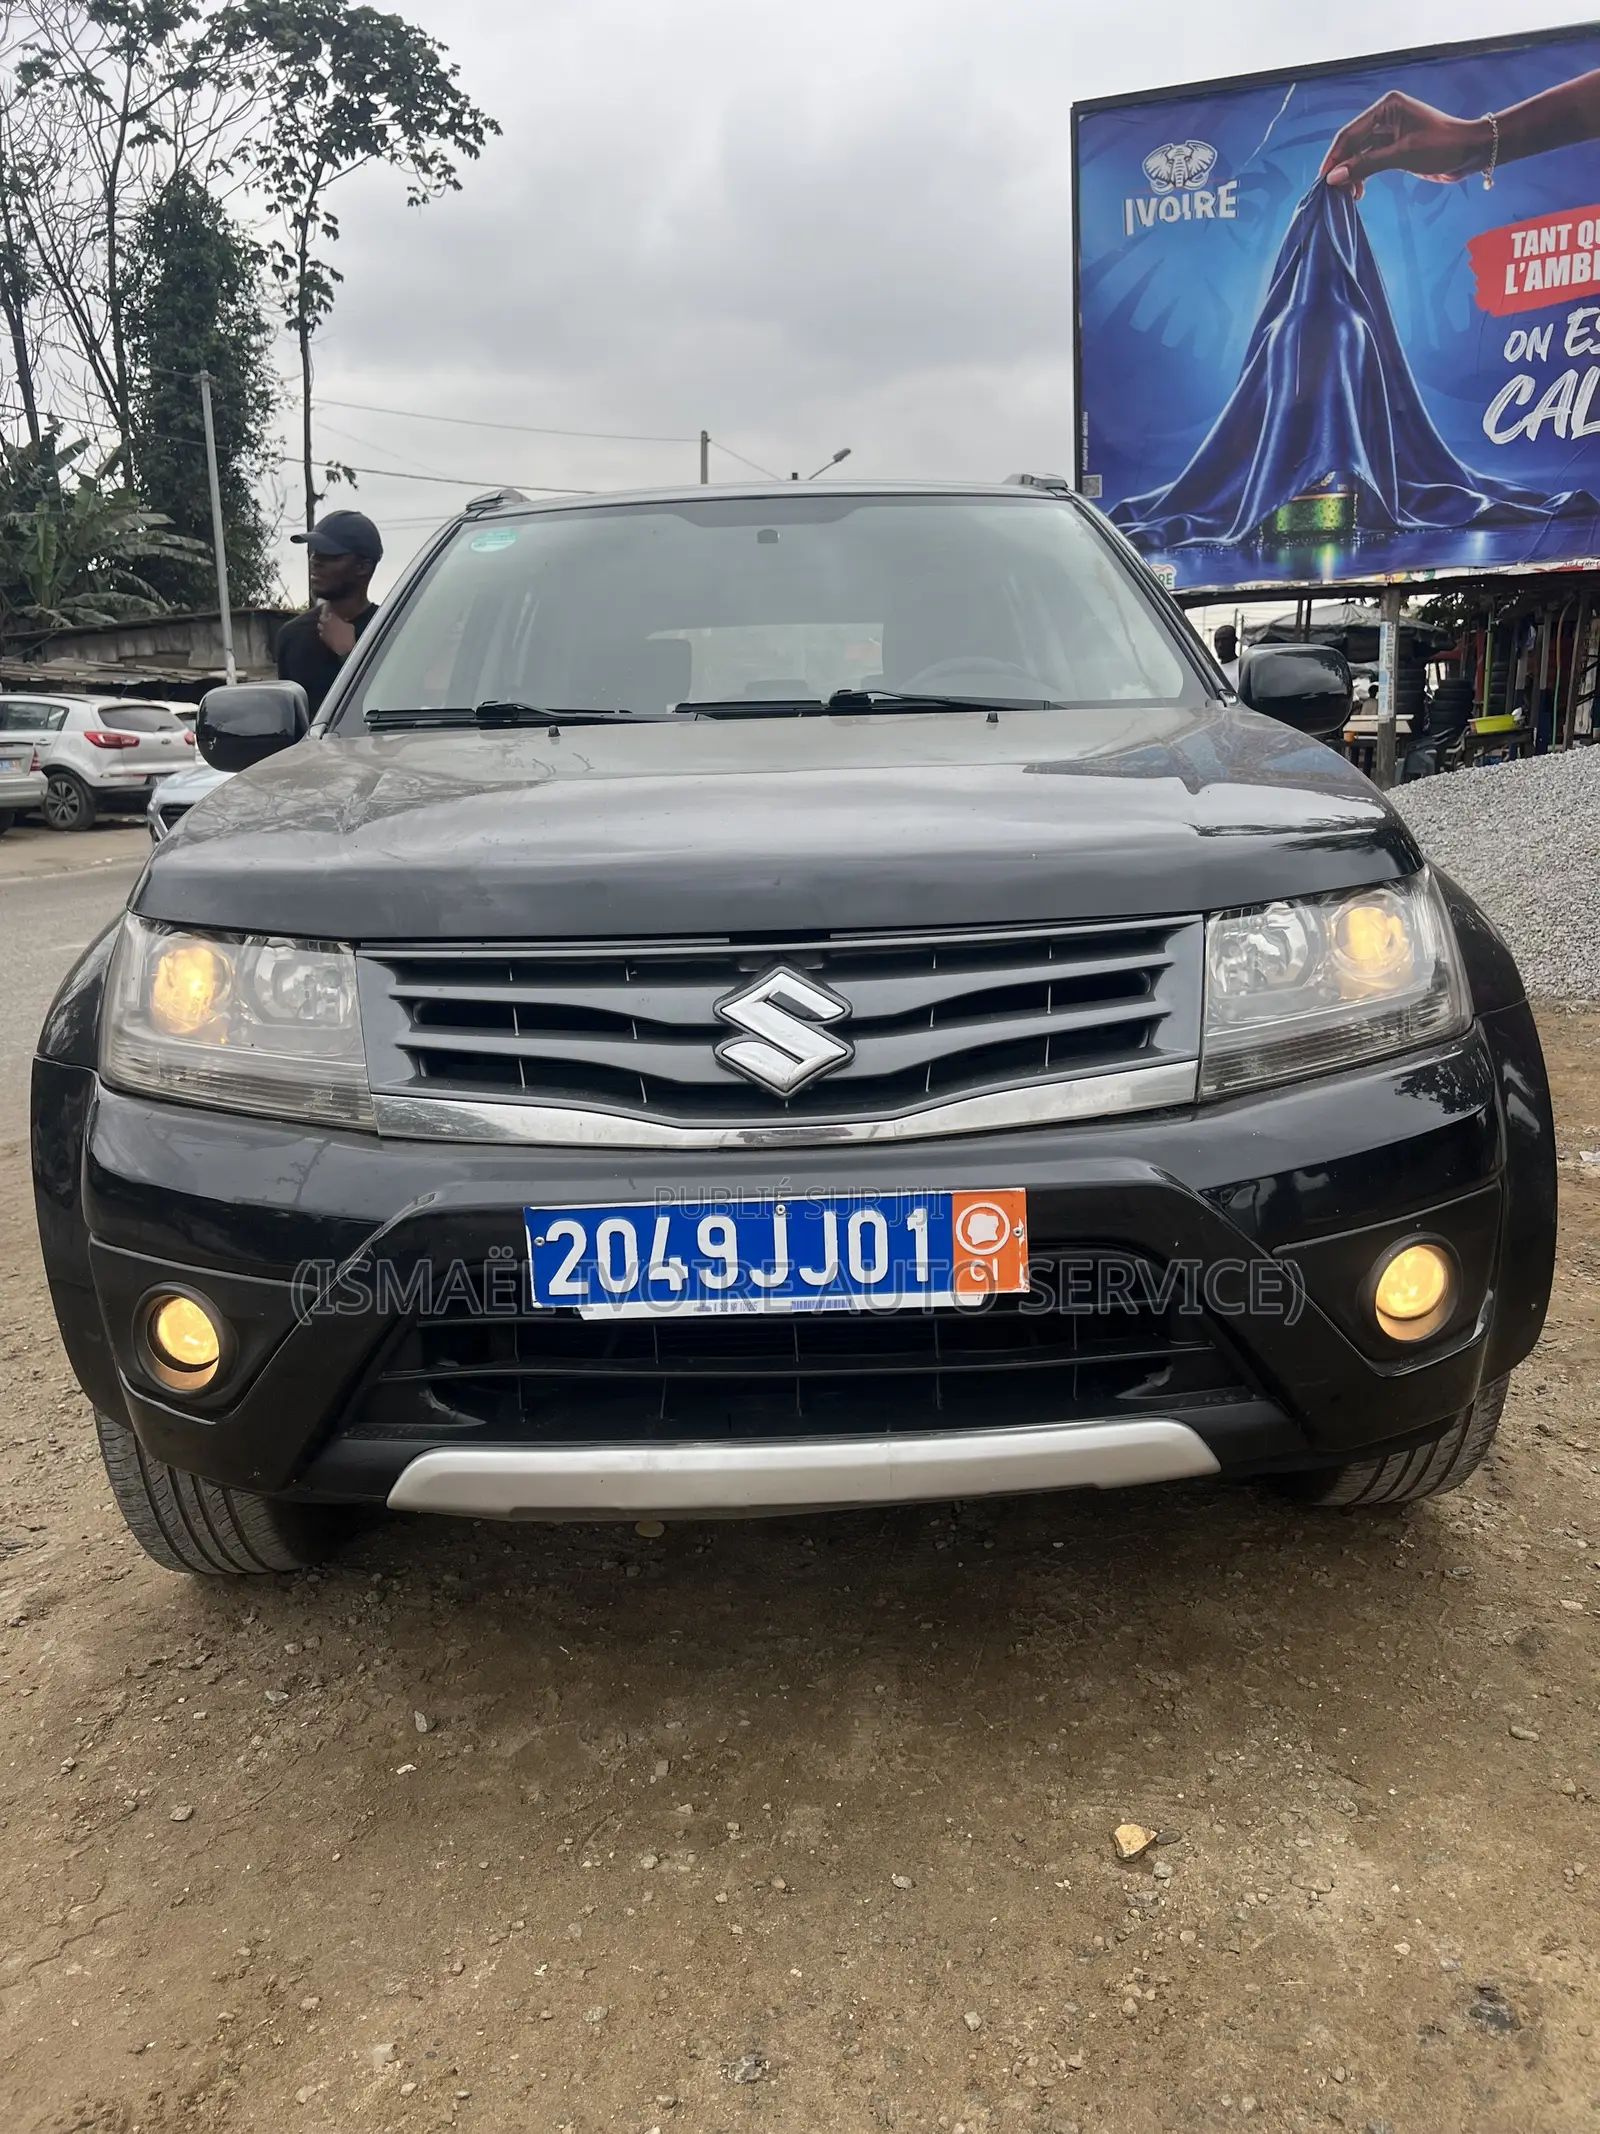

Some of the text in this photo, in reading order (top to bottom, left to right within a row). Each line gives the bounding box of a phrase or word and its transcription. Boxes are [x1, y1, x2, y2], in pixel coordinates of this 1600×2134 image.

[1124, 180, 1239, 236] IVOIRE
[1511, 223, 1573, 258] TANT
[1503, 323, 1553, 363] ON
